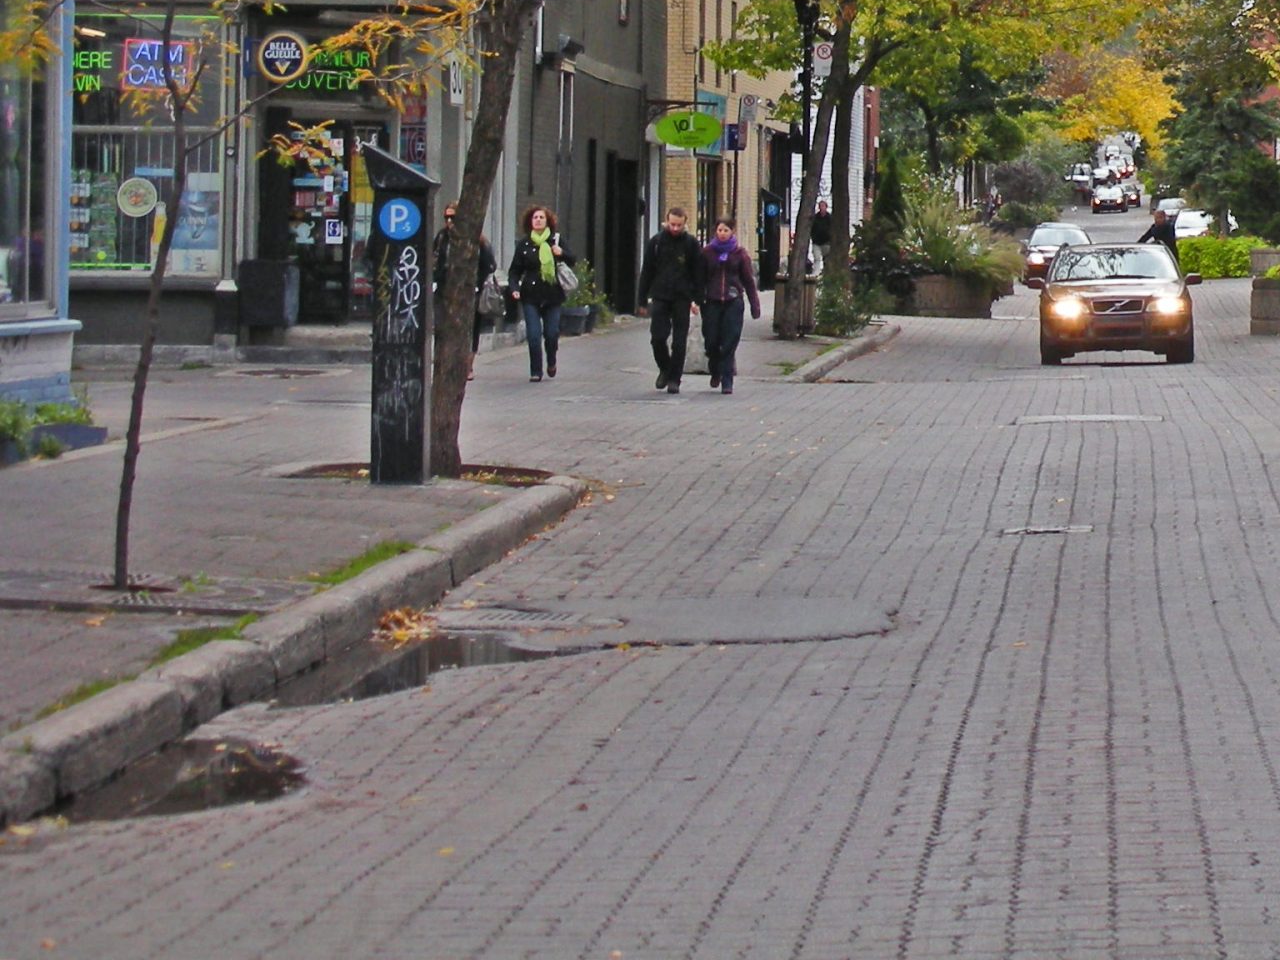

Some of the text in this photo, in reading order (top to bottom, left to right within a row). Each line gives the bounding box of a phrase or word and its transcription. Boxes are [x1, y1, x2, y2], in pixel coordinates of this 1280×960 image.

[264, 50, 301, 59] GUEULE
[269, 42, 297, 51] BELLE
[72, 51, 113, 69] IERE
[76, 74, 101, 92] VIN
[390, 204, 409, 233] P
